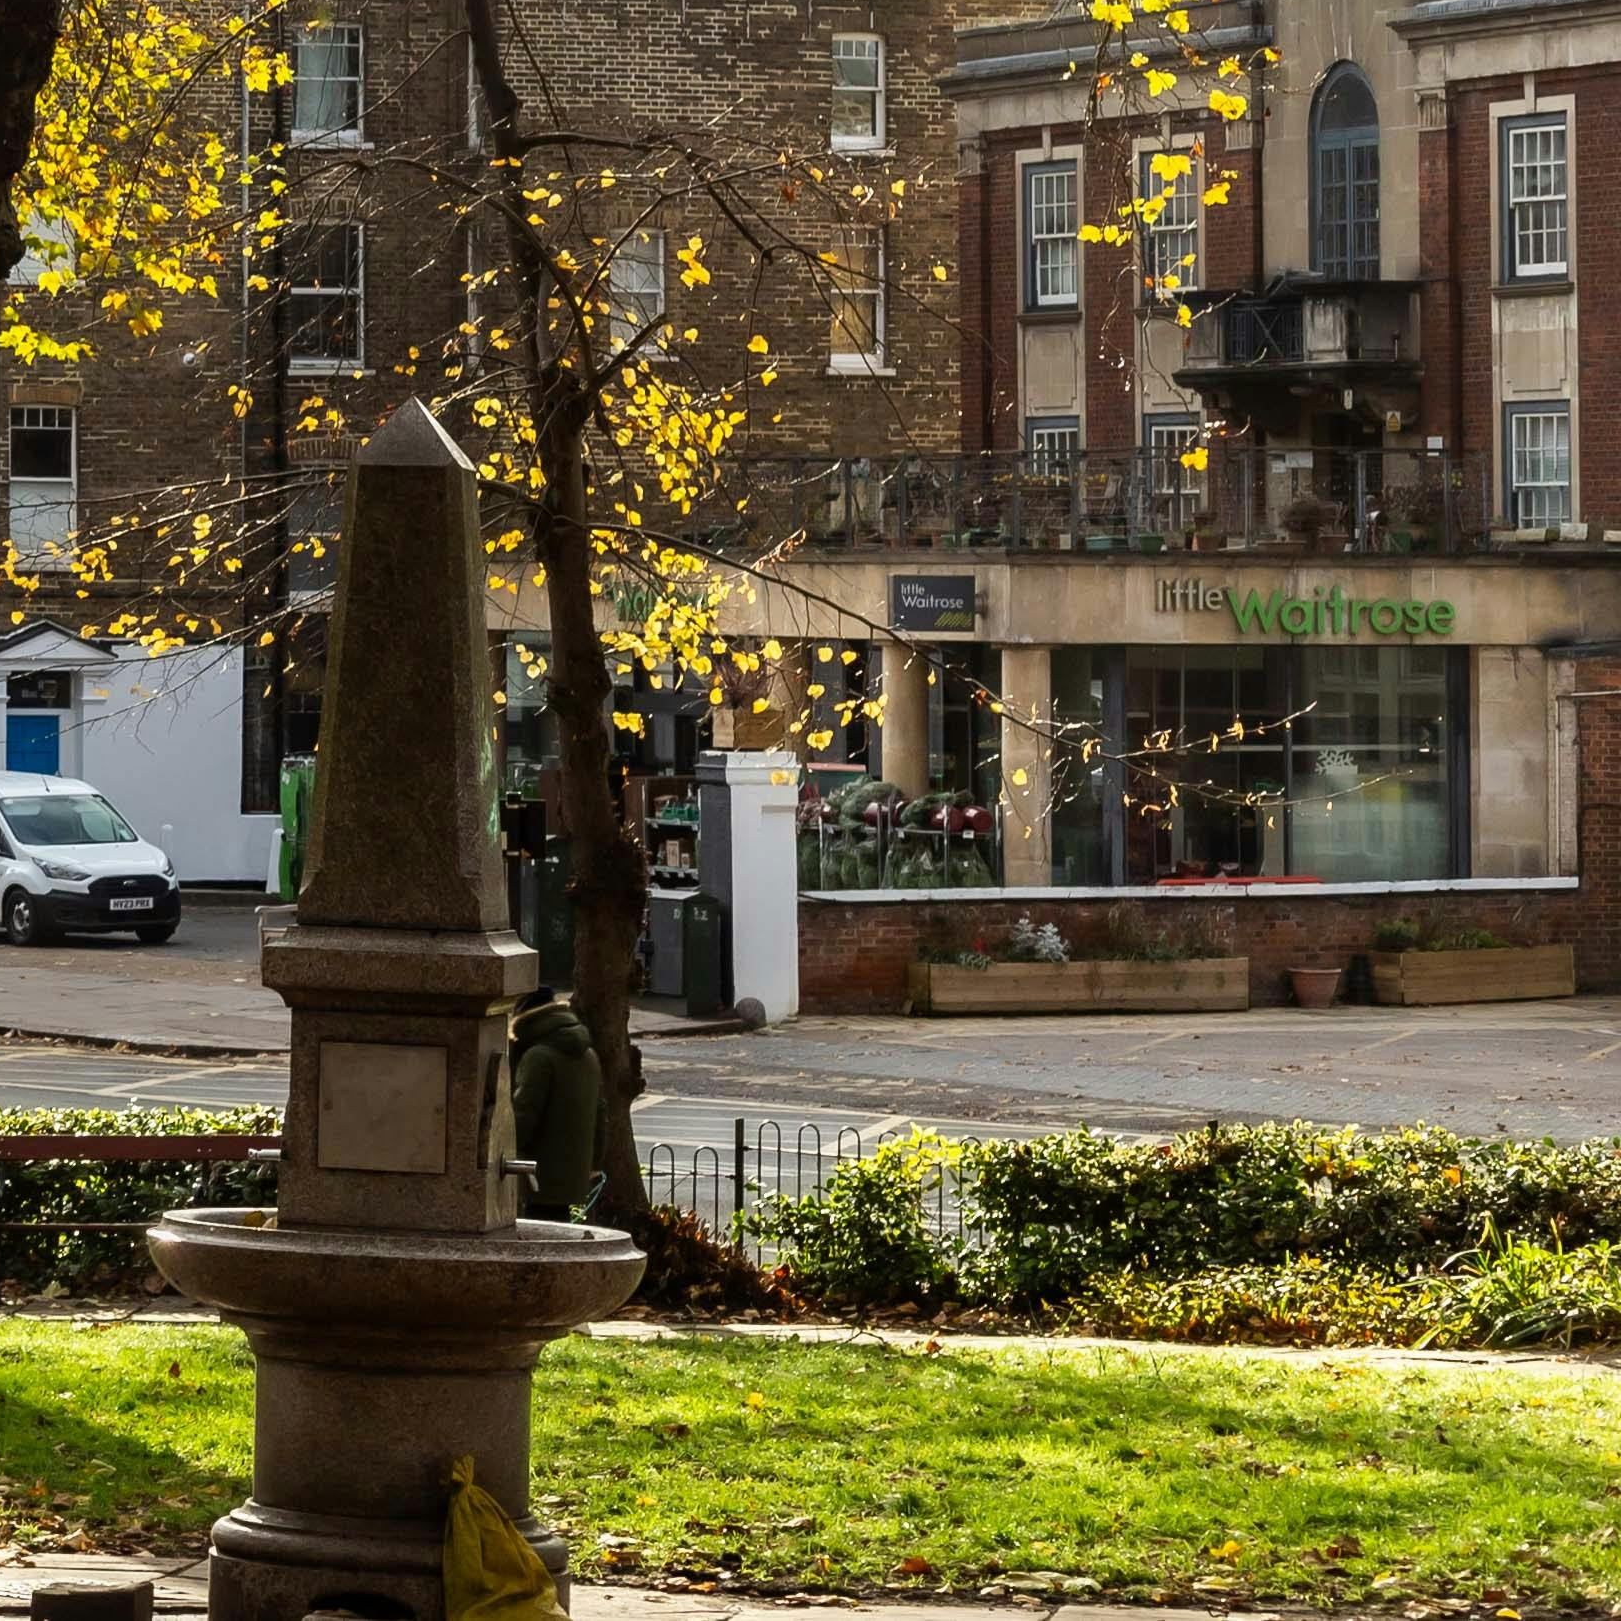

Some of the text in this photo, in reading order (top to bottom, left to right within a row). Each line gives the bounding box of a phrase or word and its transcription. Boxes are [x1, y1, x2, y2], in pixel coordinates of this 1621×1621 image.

[900, 583, 925, 595] little
[902, 594, 965, 609] Waitrose
[1156, 578, 1455, 635] little Waitrose
